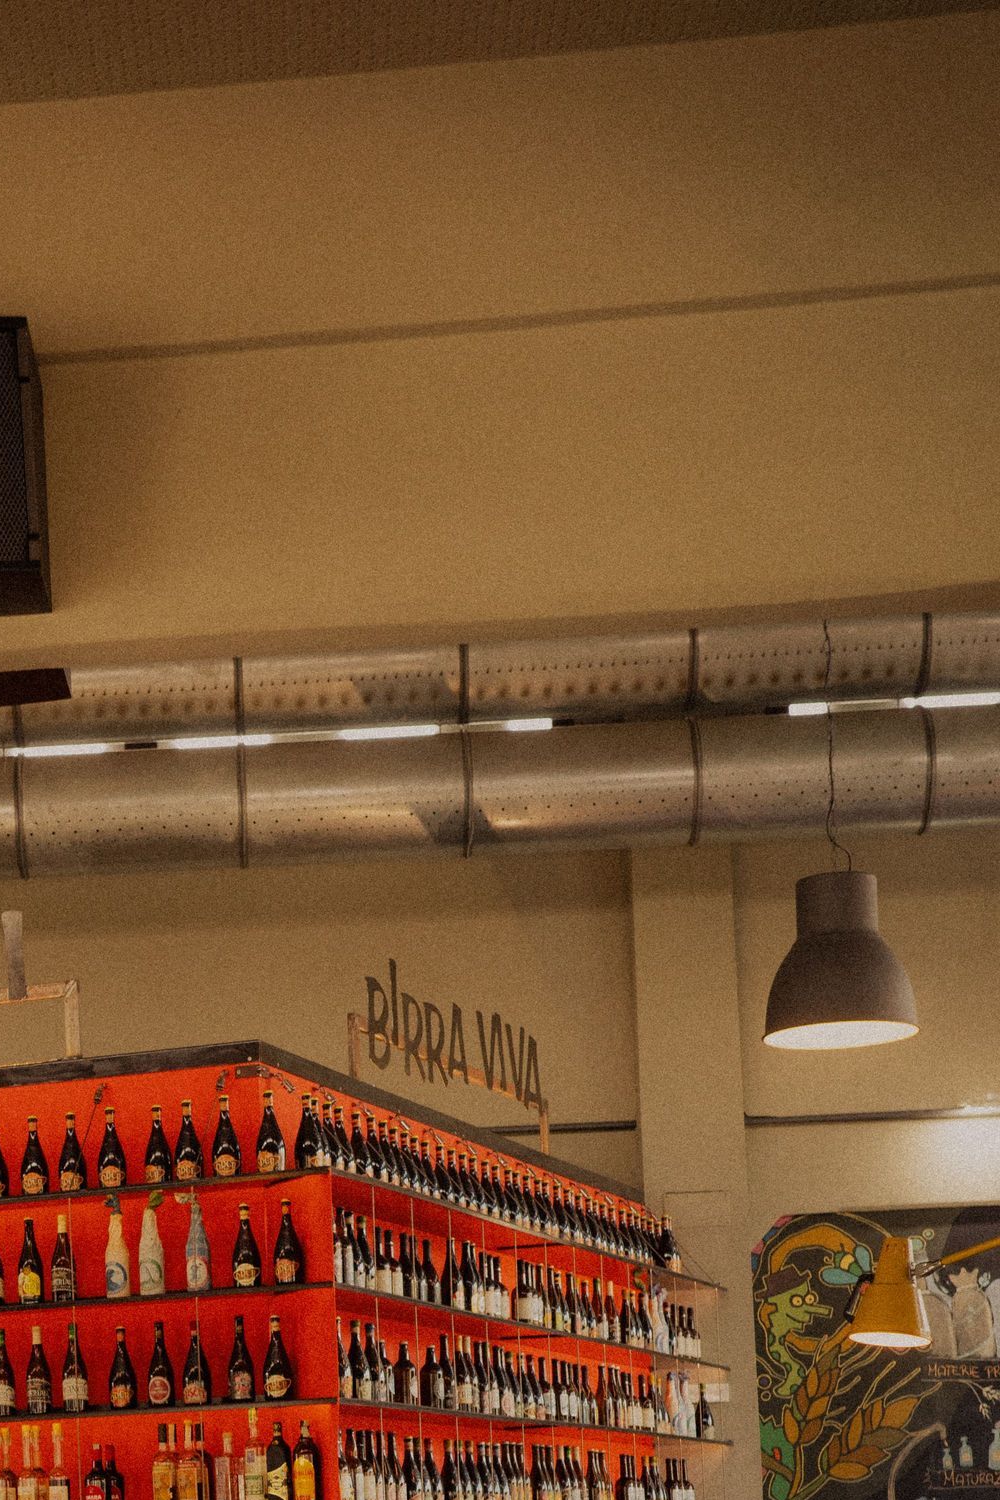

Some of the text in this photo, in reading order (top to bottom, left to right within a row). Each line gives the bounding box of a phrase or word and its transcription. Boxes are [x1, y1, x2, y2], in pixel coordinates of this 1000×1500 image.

[365, 958, 544, 1117] BIRRA VIVA
[928, 1363, 979, 1378] MATERIE
